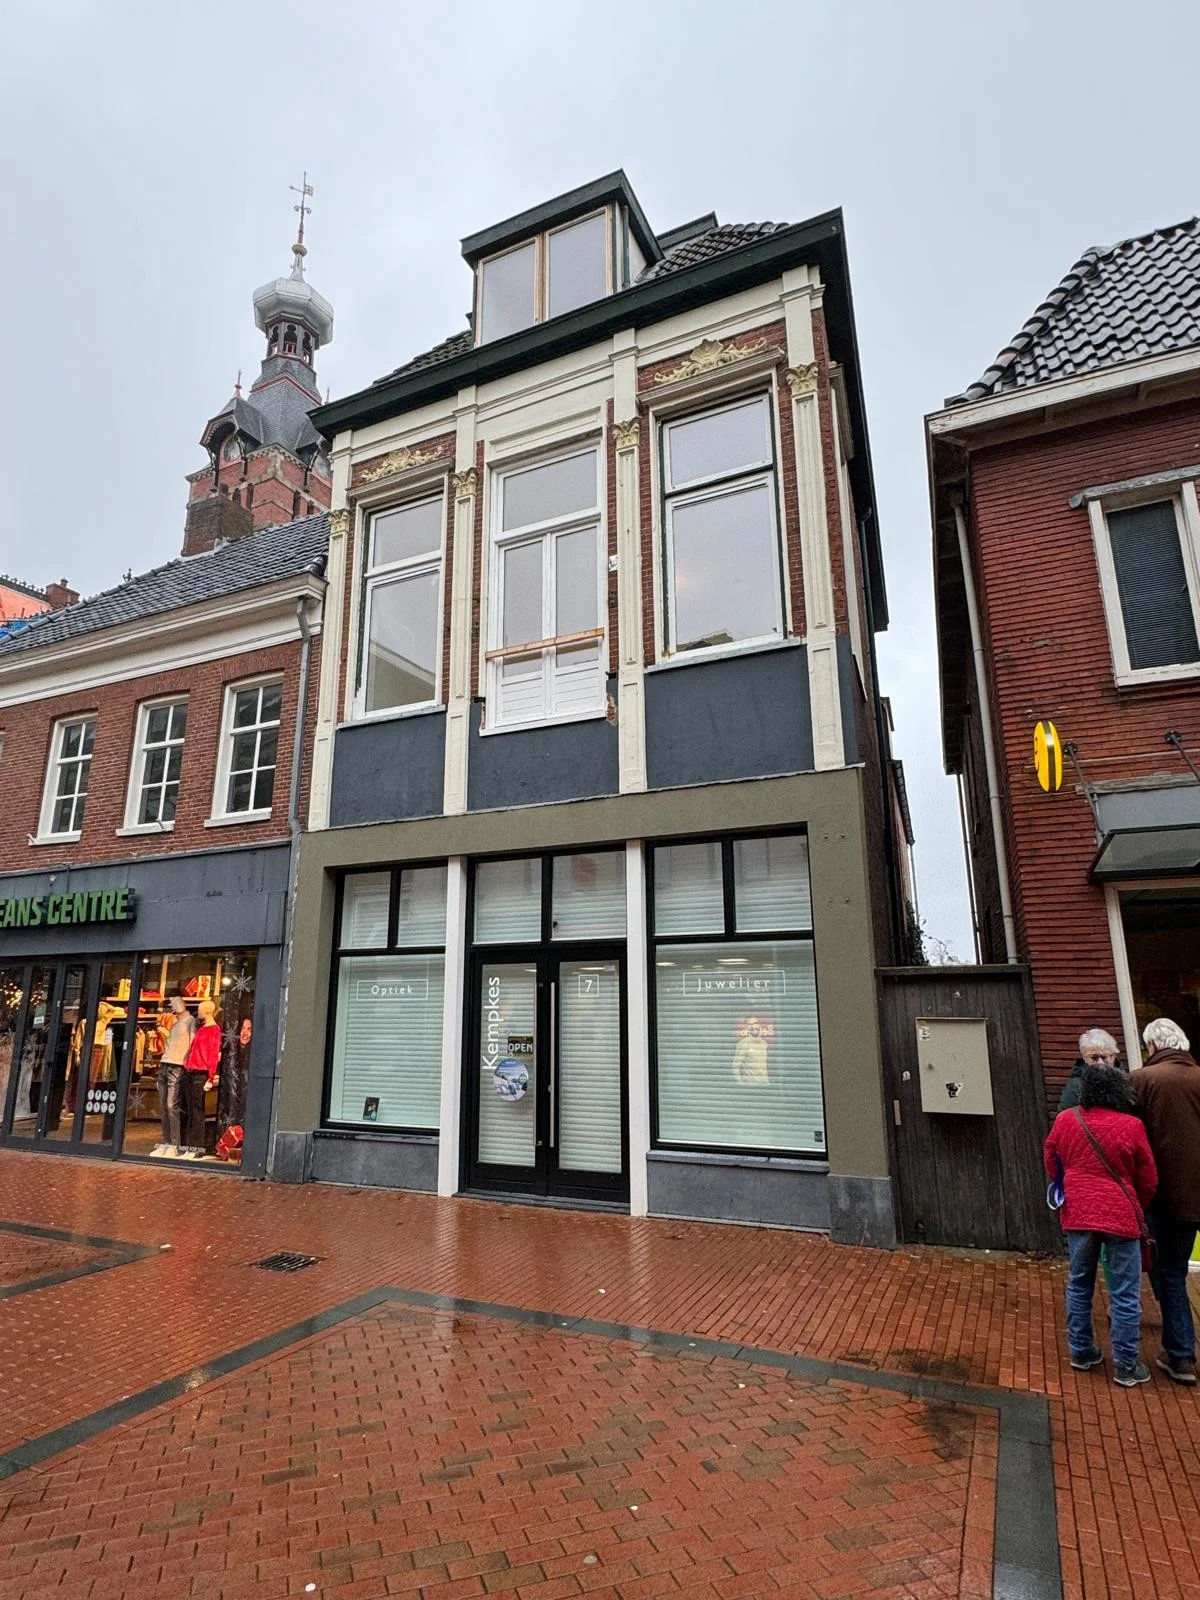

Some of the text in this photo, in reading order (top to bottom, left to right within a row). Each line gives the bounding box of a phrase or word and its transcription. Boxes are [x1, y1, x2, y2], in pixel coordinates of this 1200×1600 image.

[47, 888, 129, 925] CENTRE
[371, 984, 413, 997] Optiek
[585, 979, 593, 993] 7
[697, 976, 770, 992] Juwelier
[482, 977, 504, 1070] Kempkes
[508, 1043, 533, 1052] OPEN
